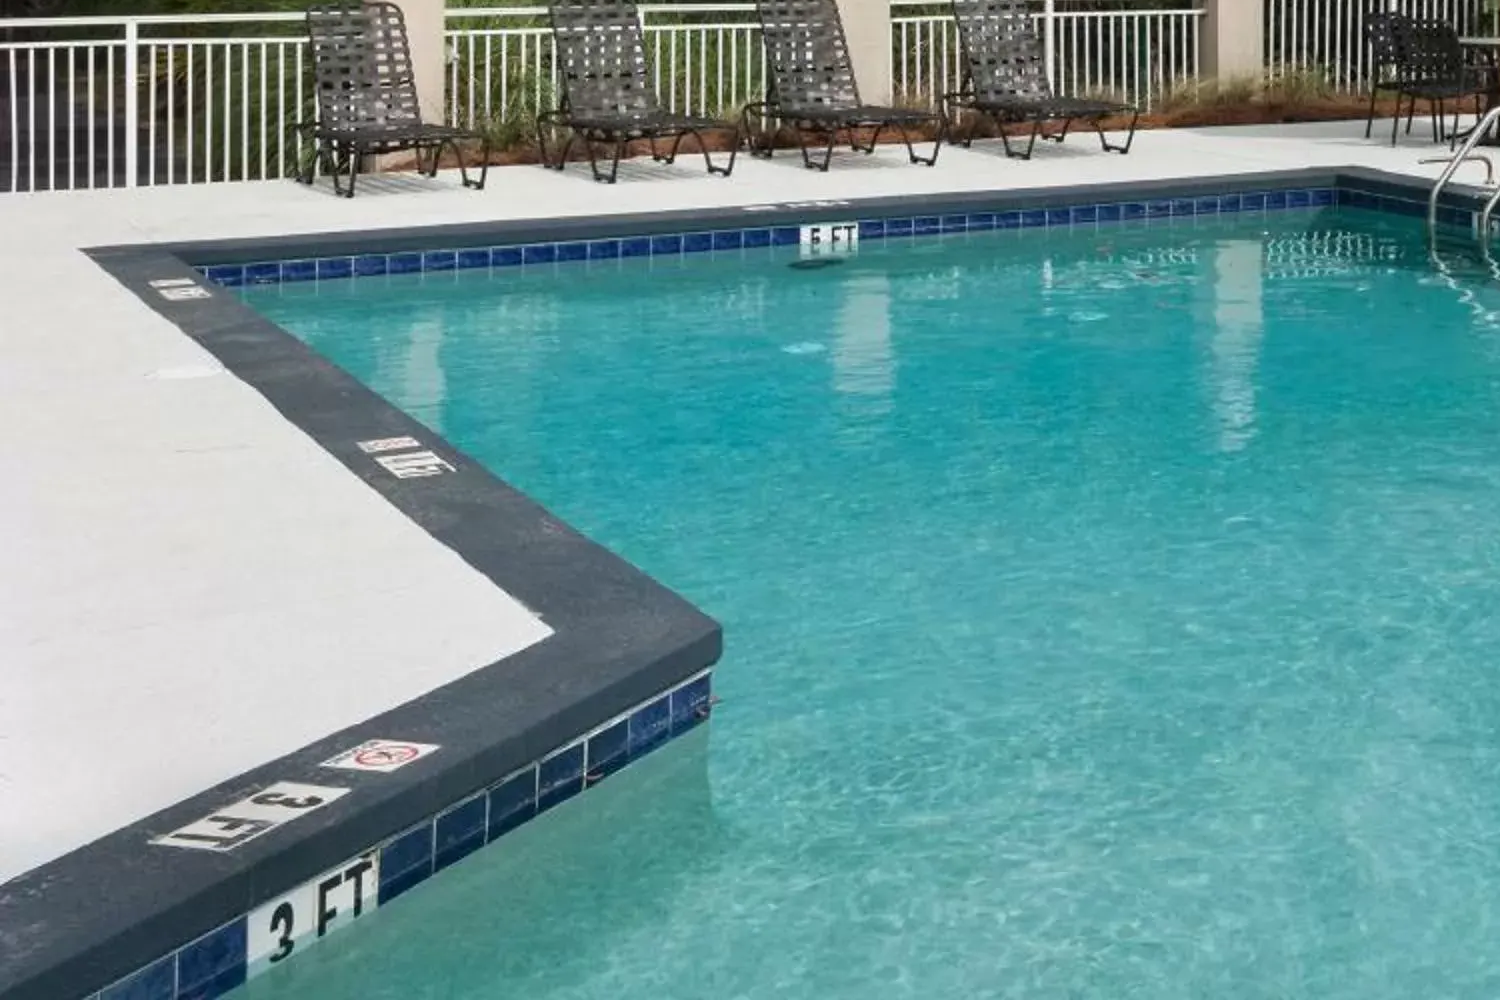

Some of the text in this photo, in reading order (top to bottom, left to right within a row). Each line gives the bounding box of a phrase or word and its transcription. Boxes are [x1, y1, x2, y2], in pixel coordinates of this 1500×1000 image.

[831, 225, 856, 247] FT
[251, 792, 324, 808] 3
[269, 858, 374, 963] 3 FT
